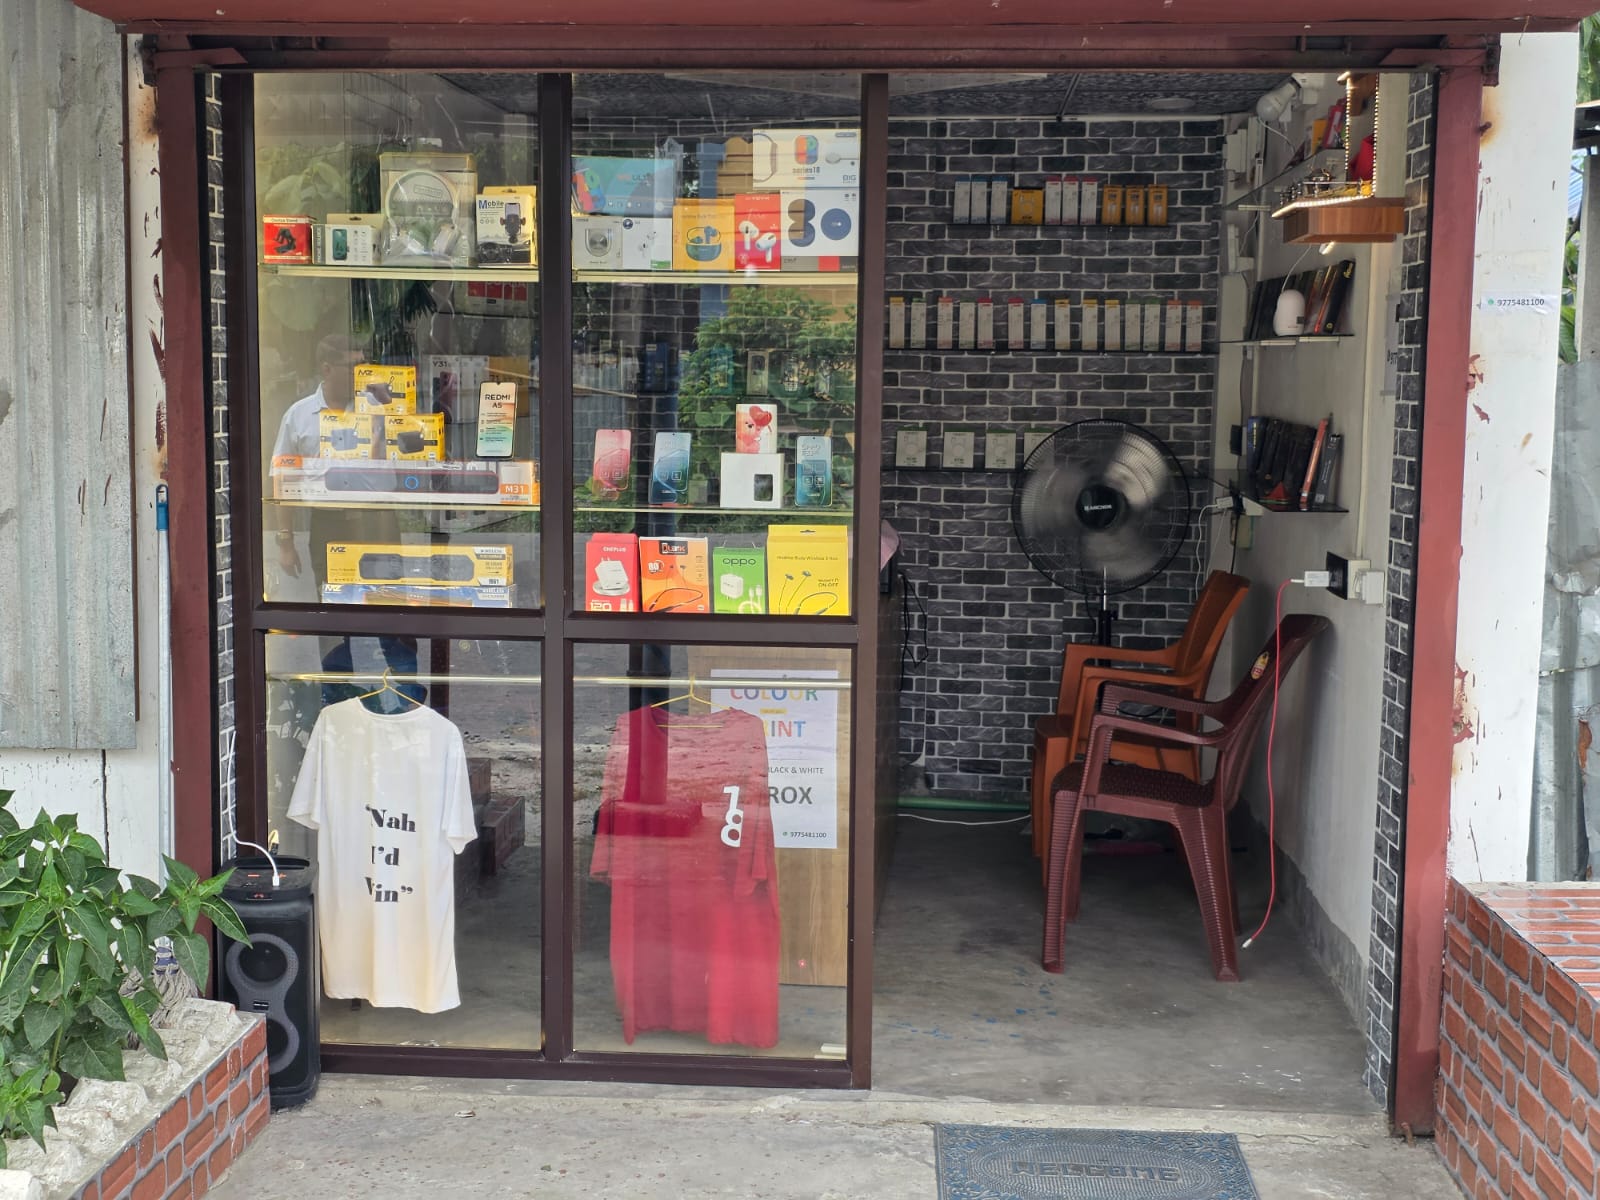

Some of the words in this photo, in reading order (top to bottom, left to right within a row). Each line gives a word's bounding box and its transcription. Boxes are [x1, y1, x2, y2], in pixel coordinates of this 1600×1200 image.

[1497, 298, 1544, 306] 9775481100
[505, 485, 524, 493] M31
[730, 689, 818, 701] COLOUR
[799, 767, 825, 775] WHITE
[768, 786, 813, 805] ROX
